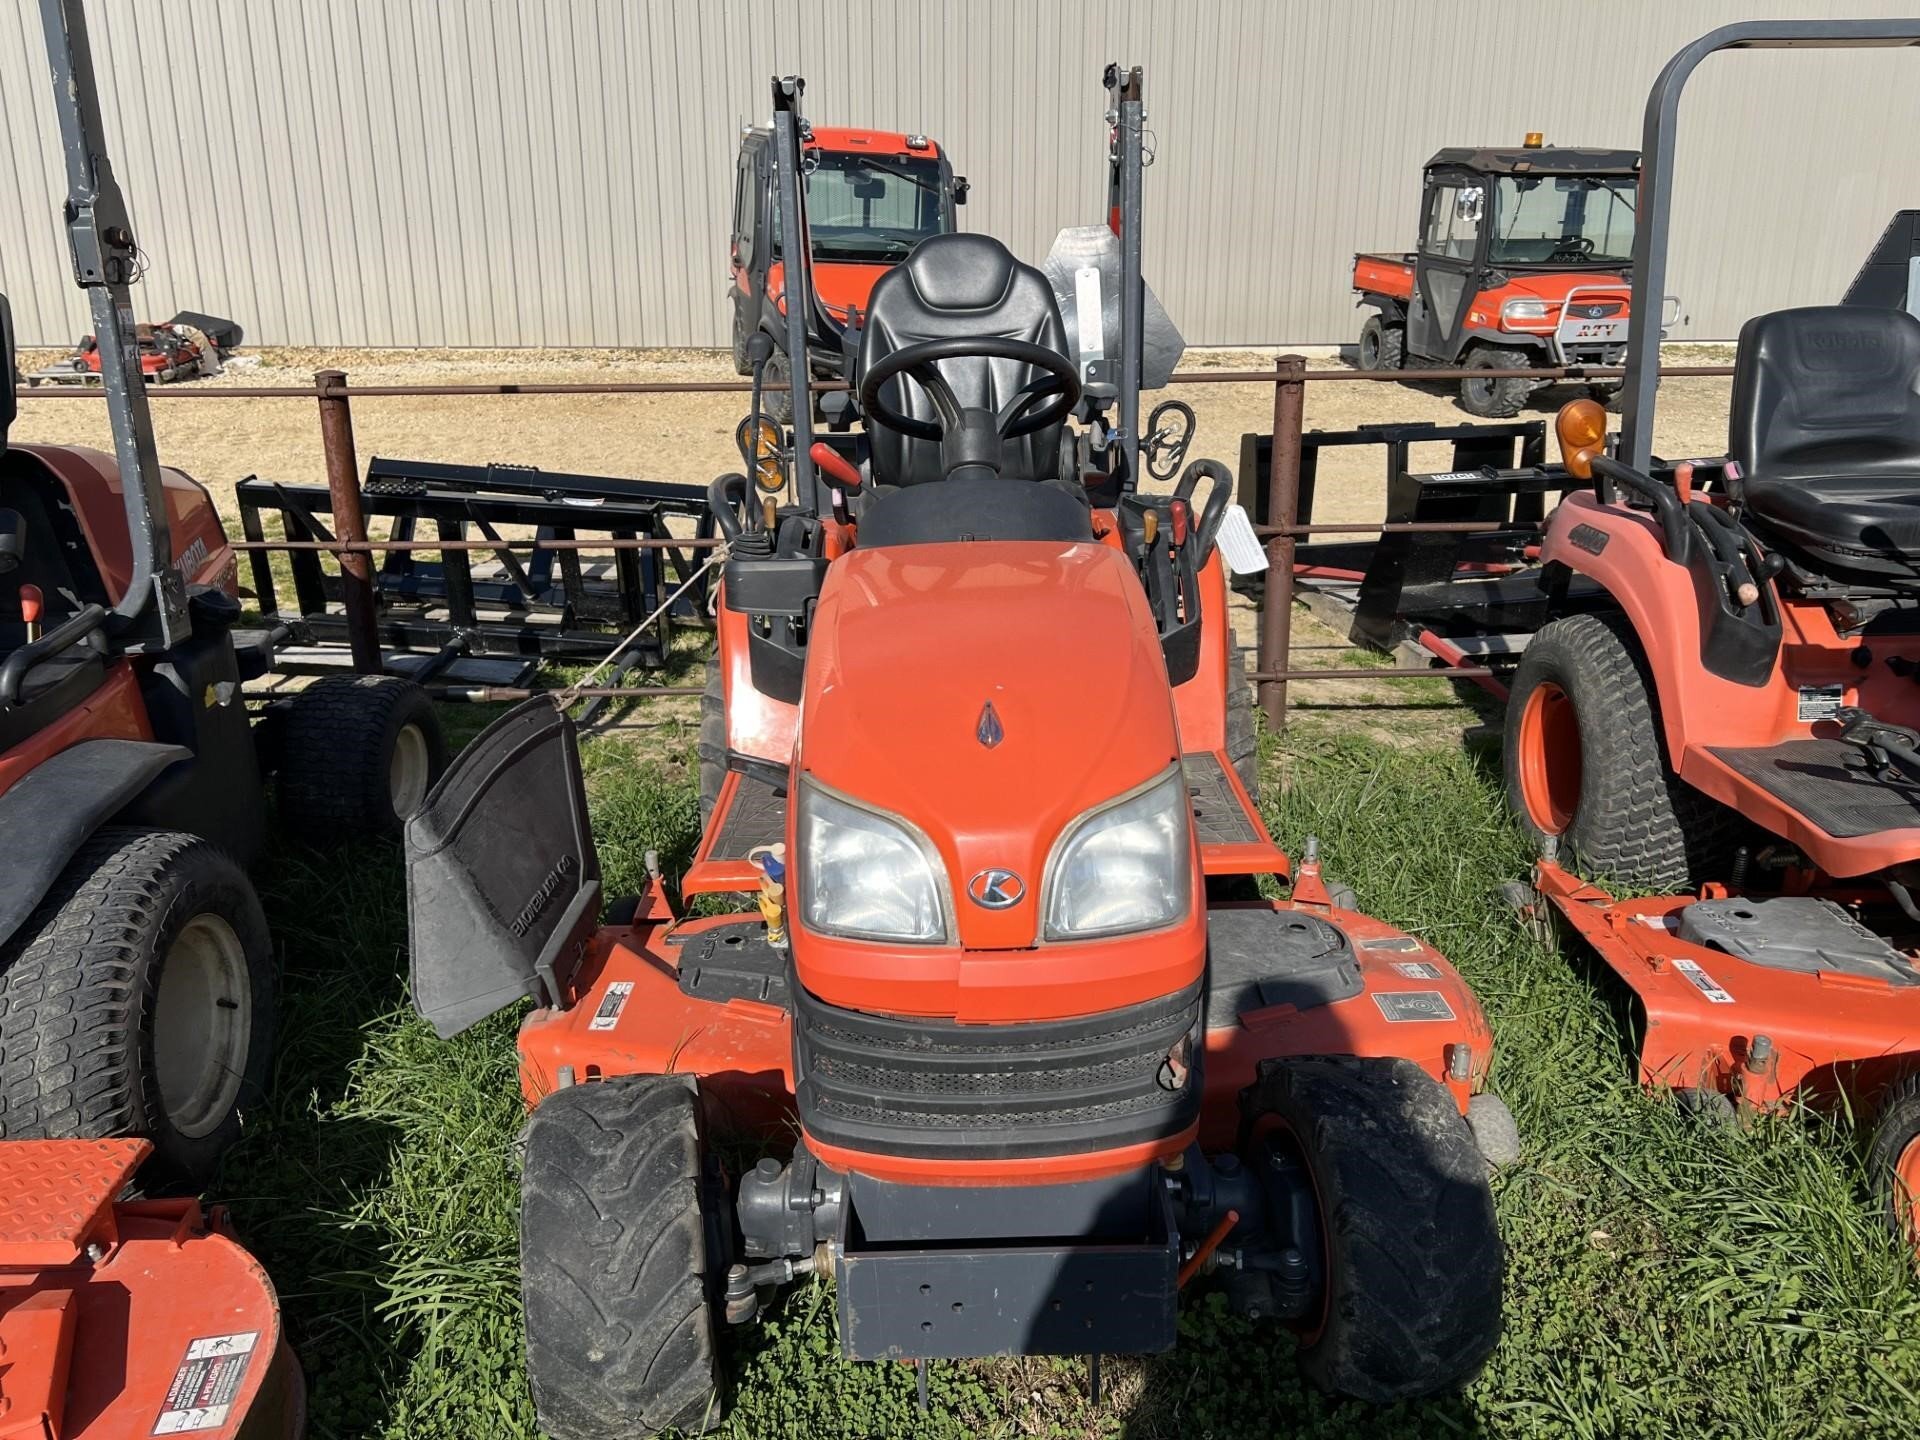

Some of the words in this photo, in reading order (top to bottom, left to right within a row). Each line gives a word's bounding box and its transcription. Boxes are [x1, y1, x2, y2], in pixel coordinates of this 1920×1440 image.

[1576, 323, 1617, 337] RTV
[542, 870, 561, 897] NOT
[510, 890, 546, 938] REMOVE
[170, 1365, 188, 1399] DANGER
[203, 1361, 224, 1396] PELIGRO
